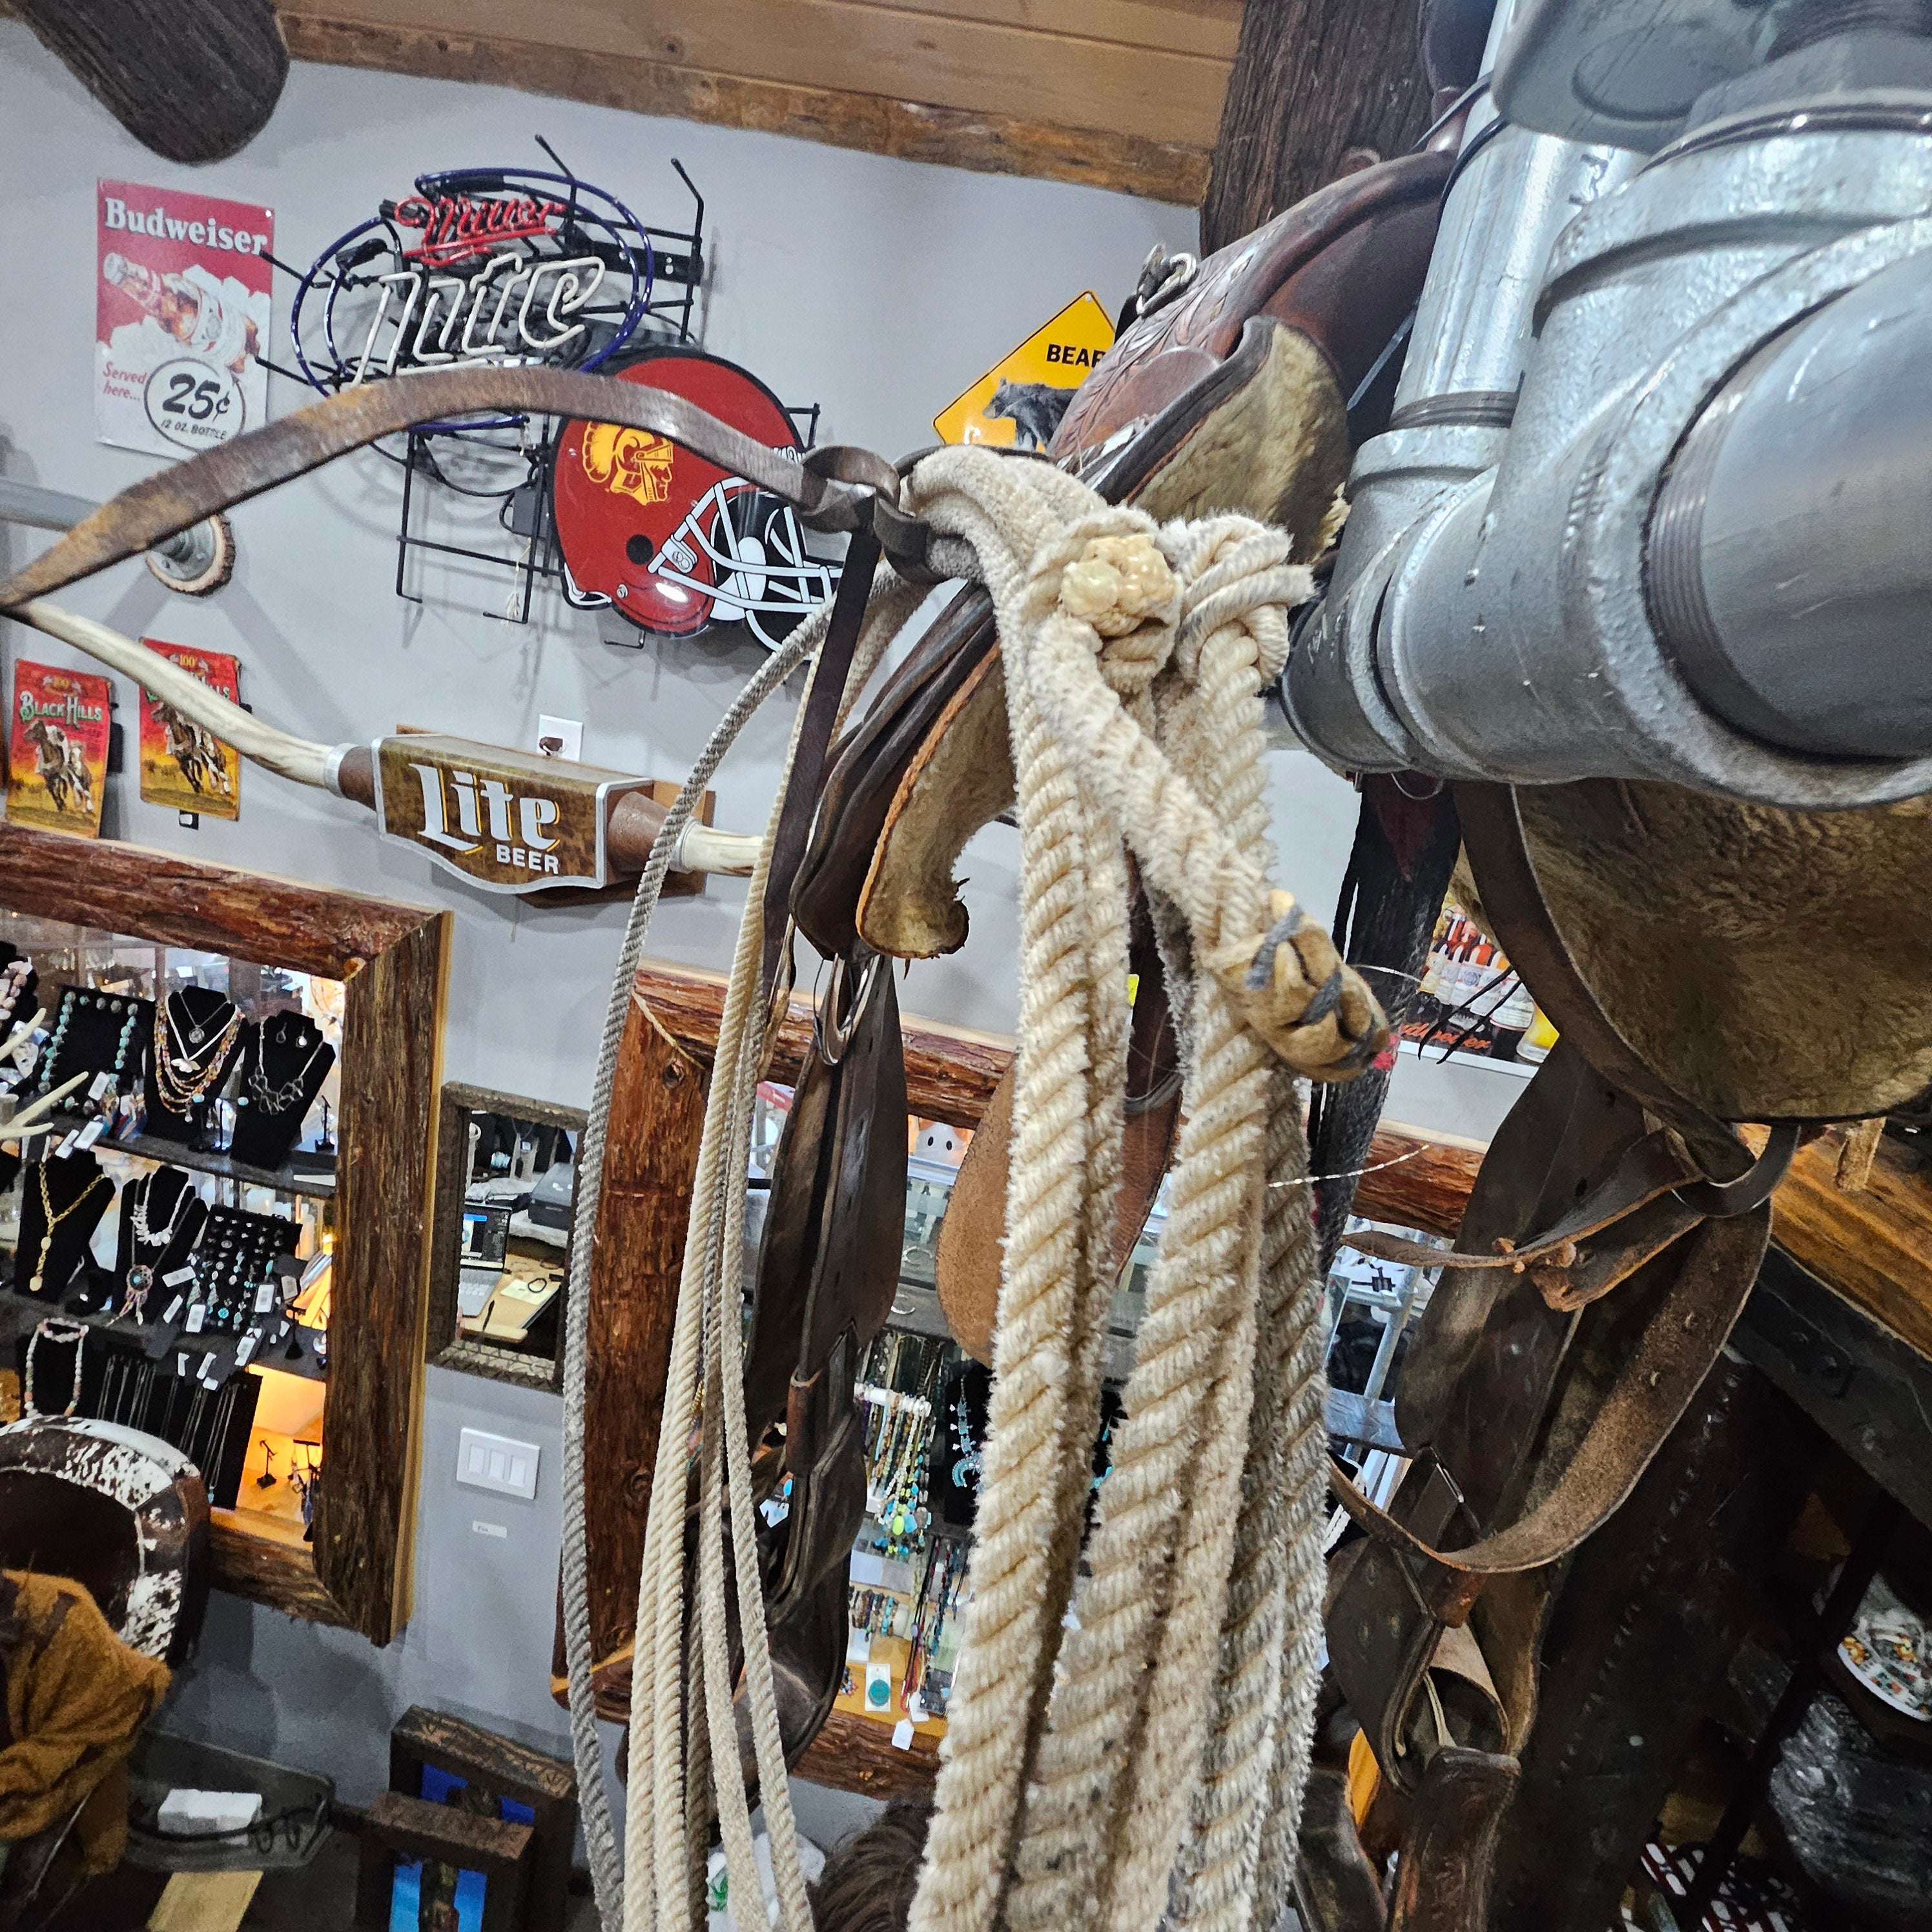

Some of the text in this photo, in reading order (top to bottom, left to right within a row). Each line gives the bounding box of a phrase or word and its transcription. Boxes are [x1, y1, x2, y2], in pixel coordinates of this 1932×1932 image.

[105, 196, 268, 256] Budweiser
[394, 196, 567, 252] Miller
[103, 360, 148, 385] Served
[162, 373, 231, 423] 25¢
[161, 418, 171, 429] 12
[408, 763, 560, 855] Lite
[496, 843, 559, 874] BEER
